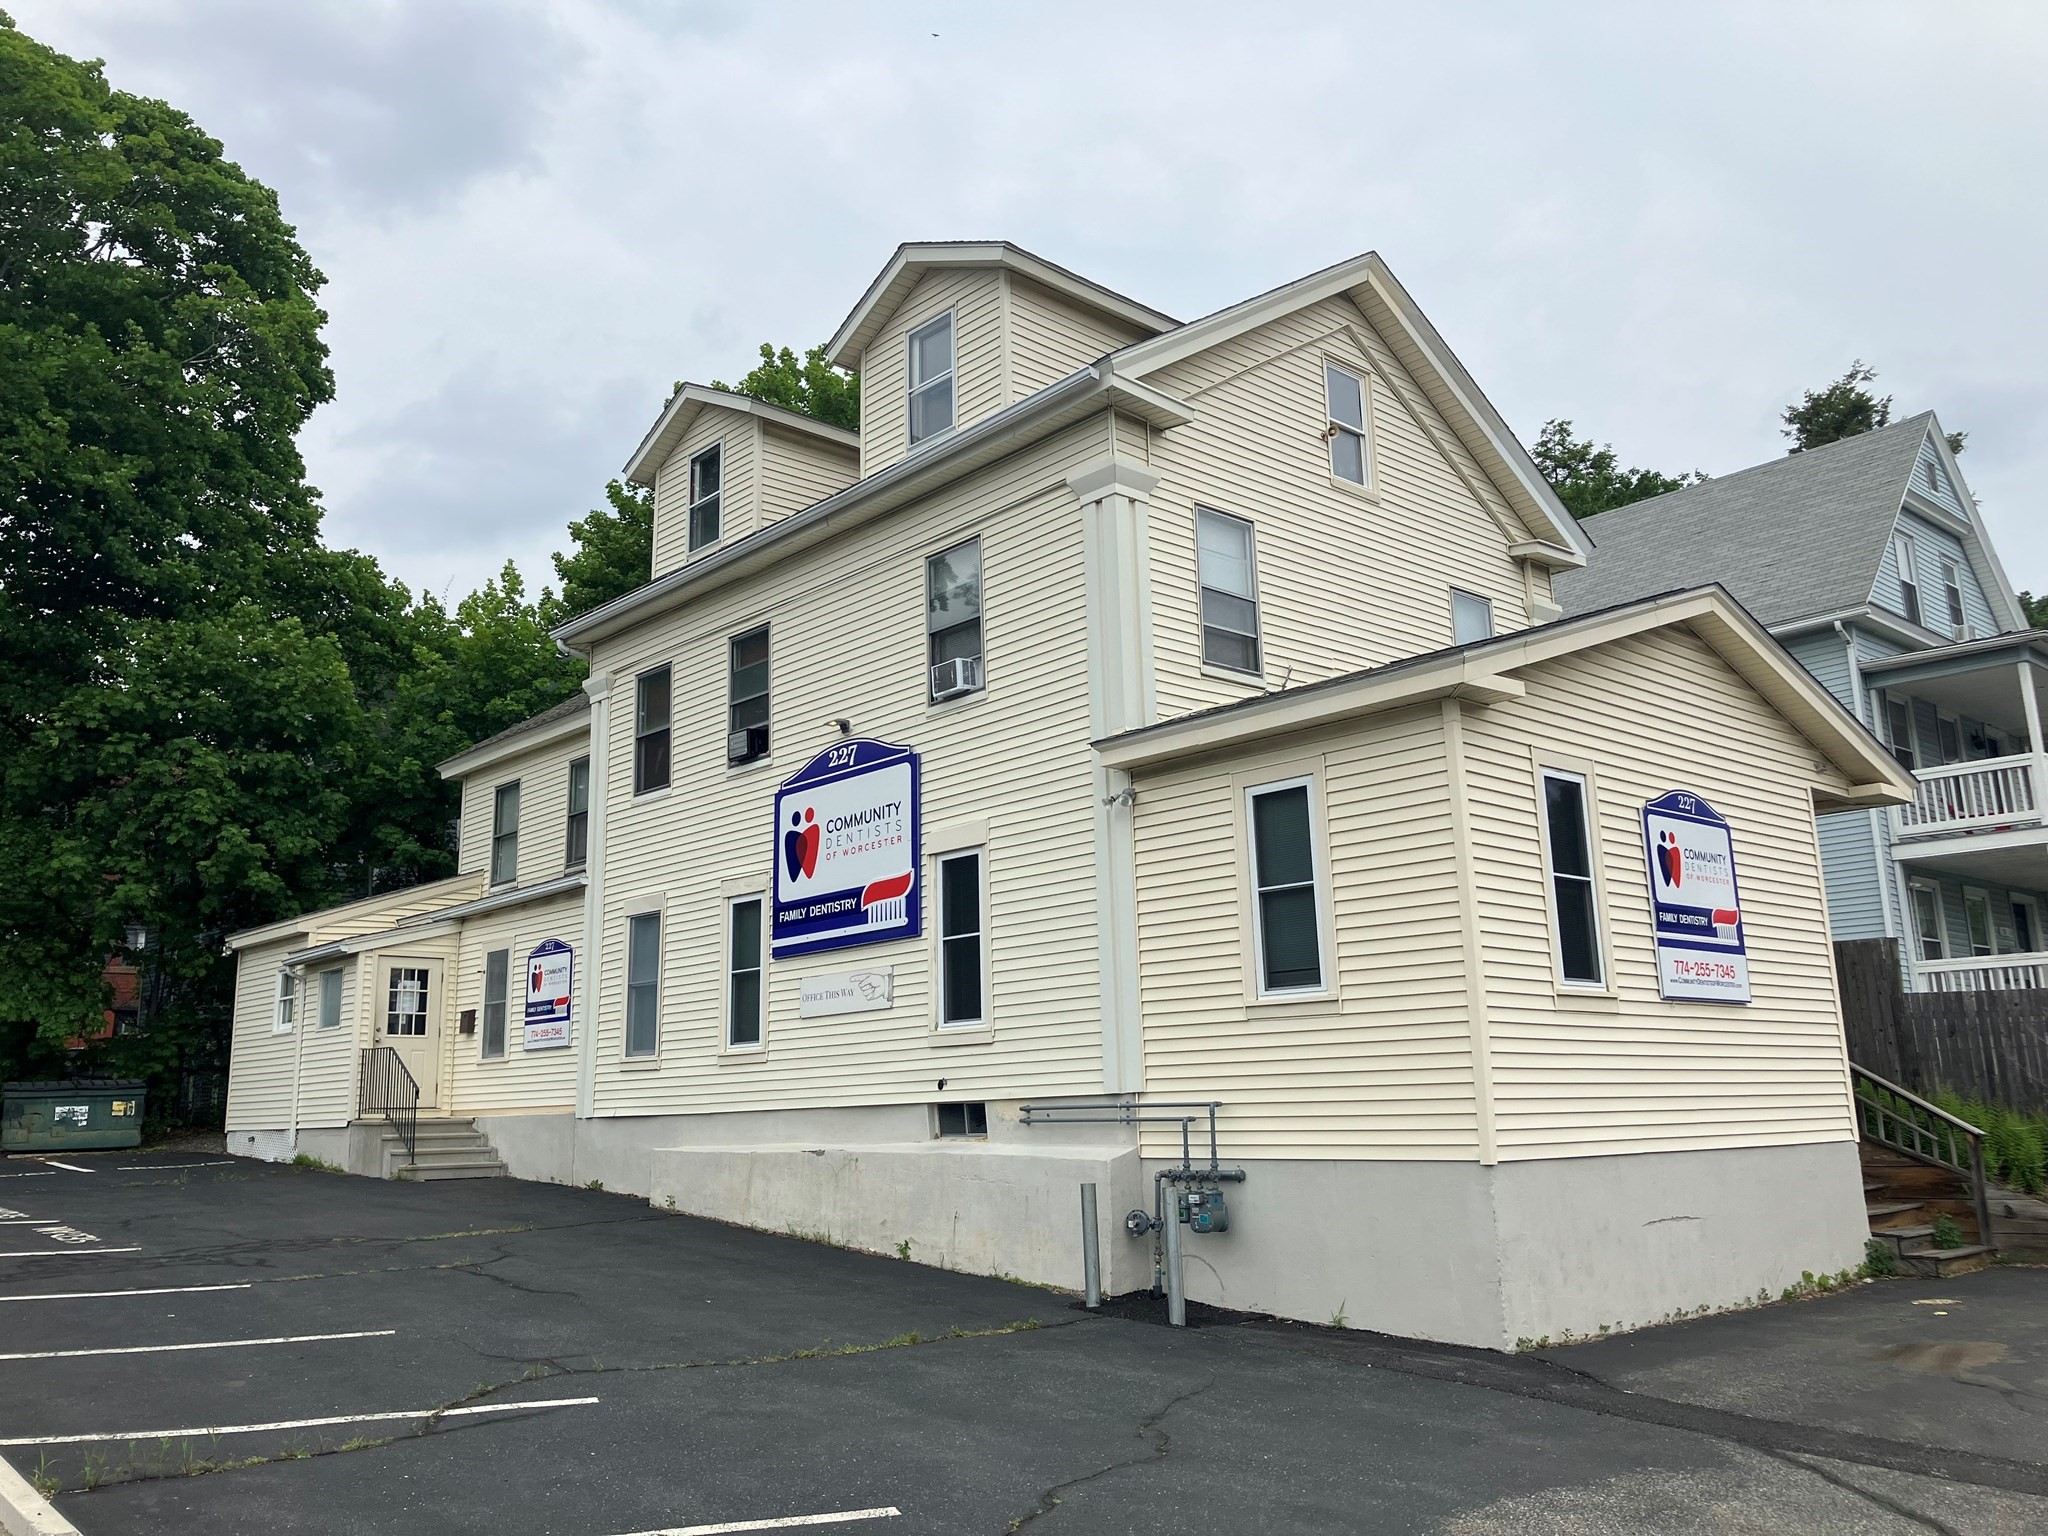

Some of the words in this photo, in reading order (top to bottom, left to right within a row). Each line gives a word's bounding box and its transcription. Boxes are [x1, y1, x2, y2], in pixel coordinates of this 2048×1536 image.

[828, 745, 858, 768] 227
[1677, 795, 1696, 814] 227
[826, 800, 902, 834] COMMUNITY
[825, 819, 902, 850] DENTISTS
[826, 850, 838, 861] OF
[842, 834, 903, 857] WORCESTER
[1683, 848, 1727, 866] COMMUNITY
[1684, 861, 1729, 877] DENTISTS
[1696, 875, 1730, 886] WORCESTER
[779, 907, 807, 923] FAMILY
[809, 897, 858, 917] DENTISTRY
[1658, 911, 1678, 923] FAMILY
[1678, 914, 1709, 927] DENTISTRY
[545, 942, 554, 951] 227
[544, 967, 568, 976] COMMUNITY
[1673, 960, 1736, 980] 774-255-7345
[531, 1027, 562, 1039] 774-255-7345
